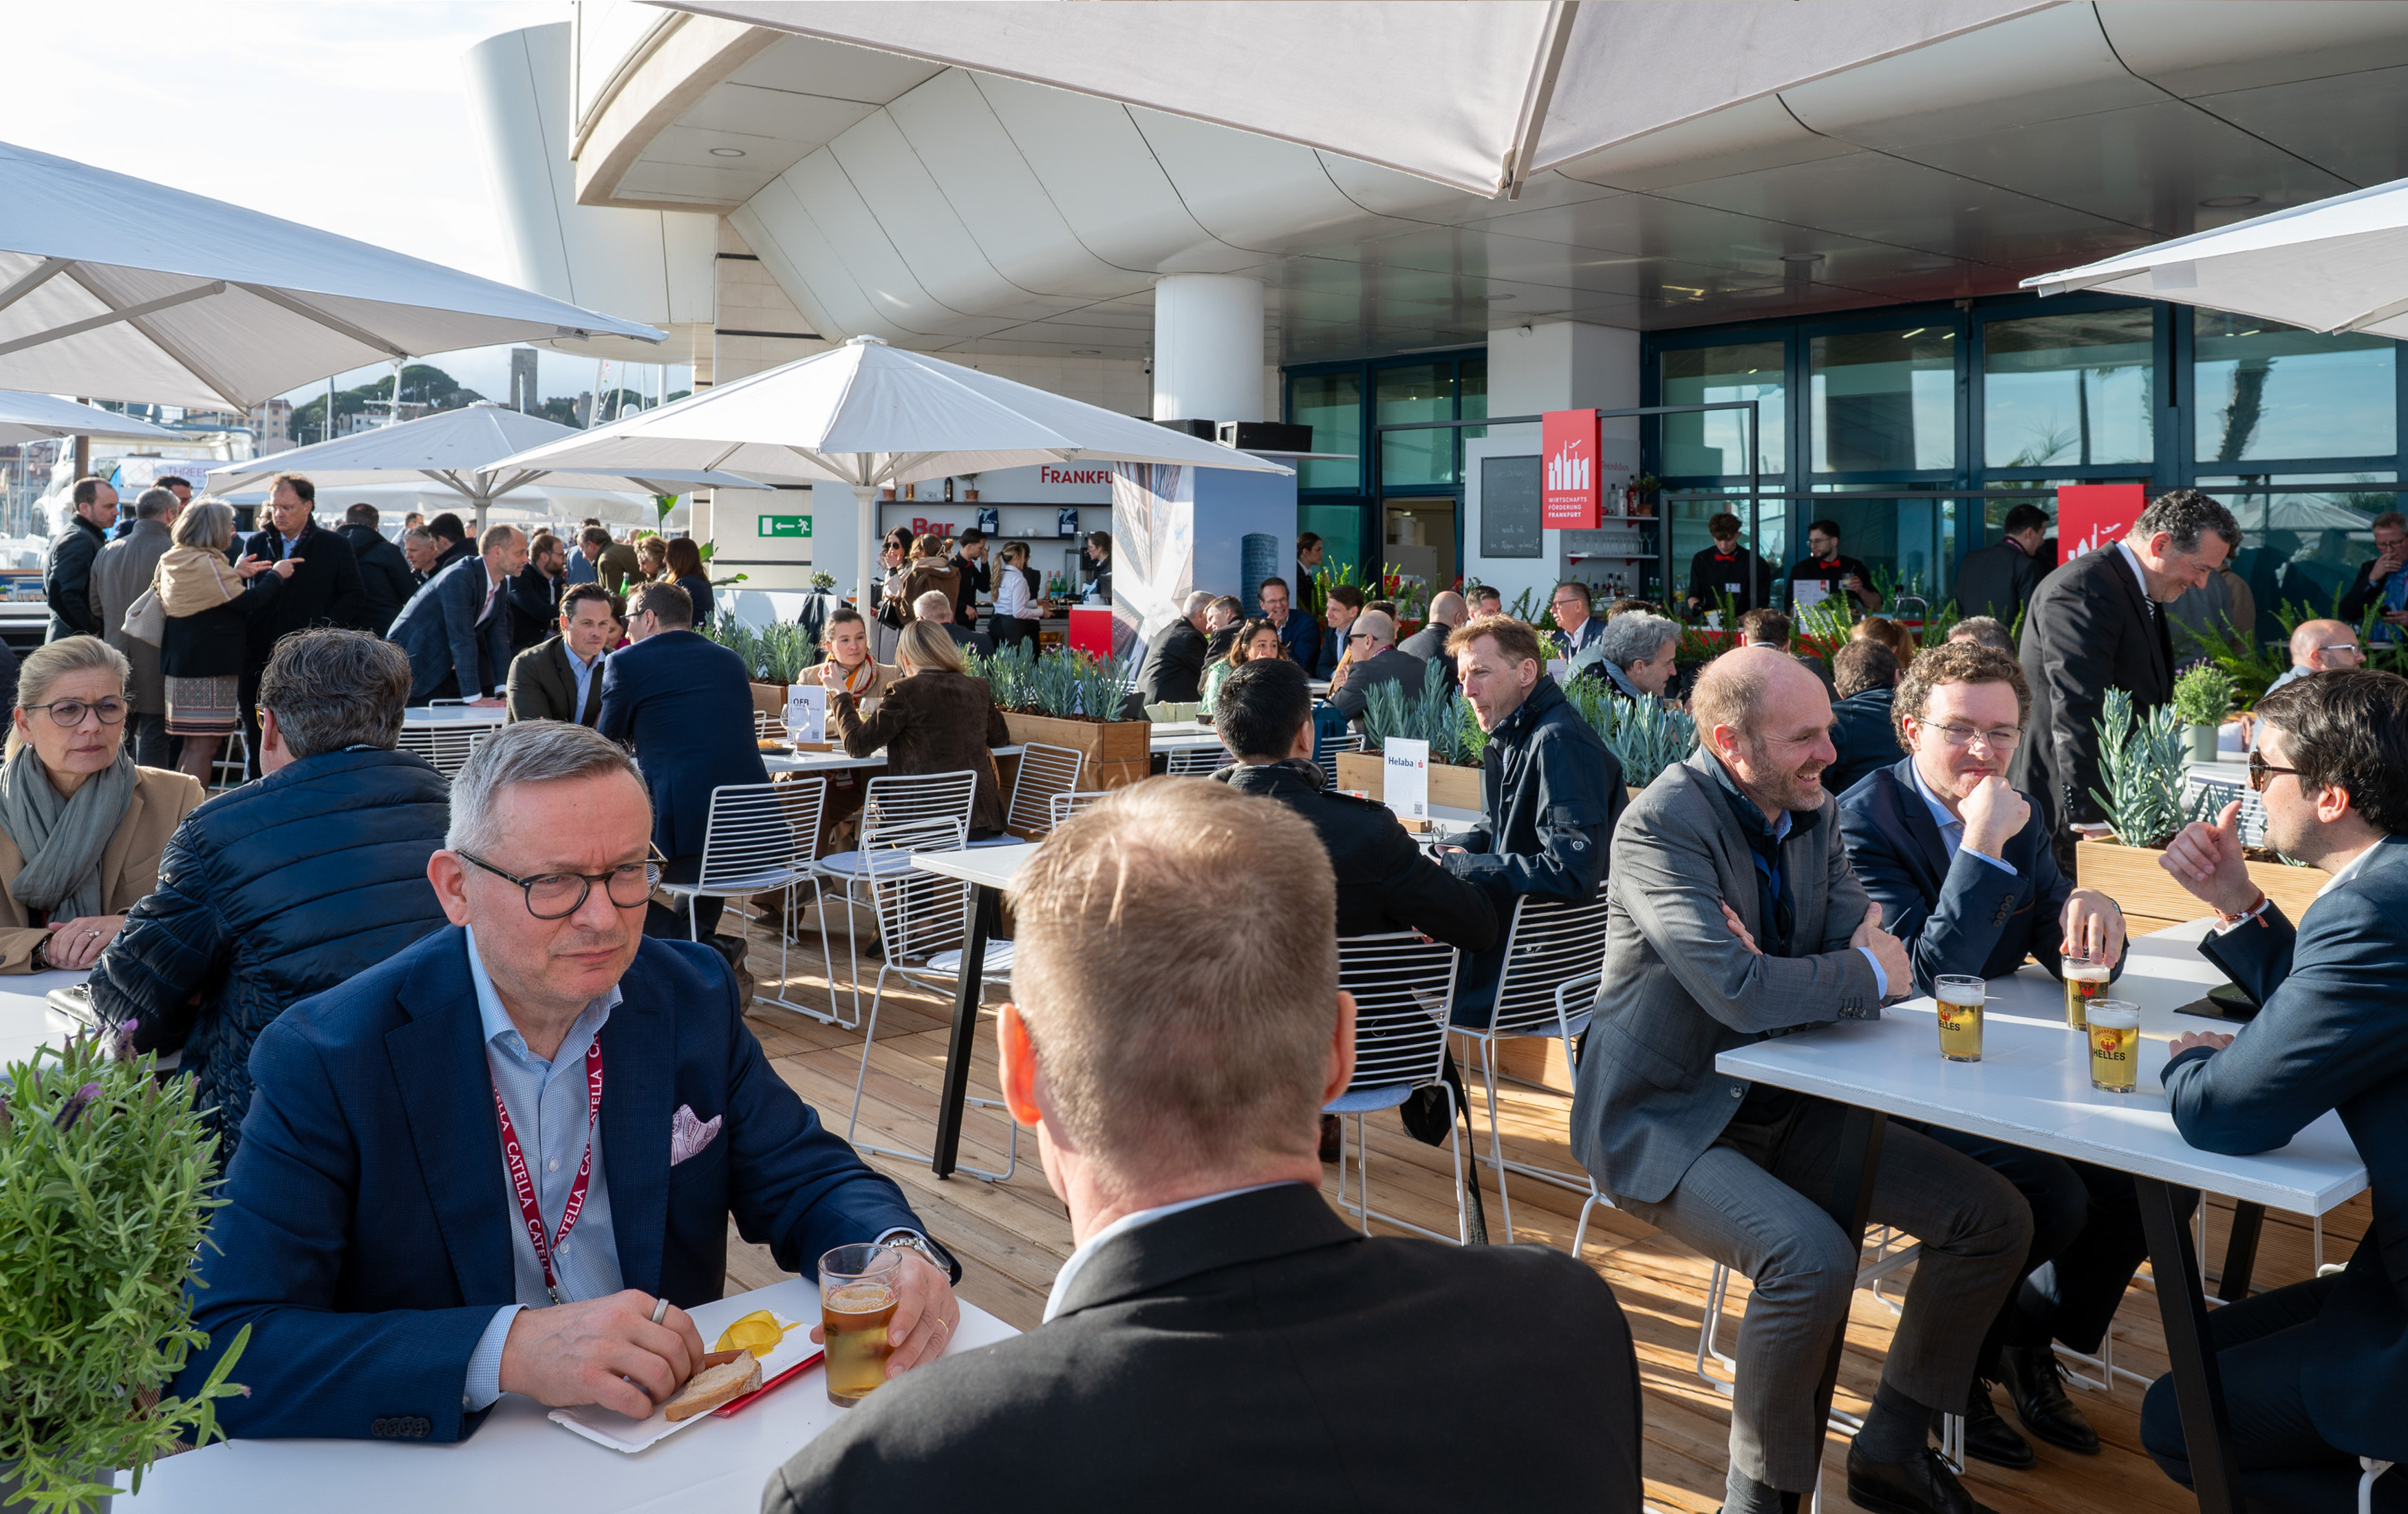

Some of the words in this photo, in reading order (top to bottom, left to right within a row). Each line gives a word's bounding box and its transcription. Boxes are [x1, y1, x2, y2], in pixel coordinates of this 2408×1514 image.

[167, 466, 211, 478] THREES
[1041, 466, 1113, 484] FRANKFU
[912, 518, 955, 537] Bar
[1388, 756, 1414, 767] Helaba
[1938, 1019, 1960, 1031] ELLES
[2094, 1048, 2125, 1061] HELLES
[590, 1069, 603, 1127] ATELLA
[507, 1142, 534, 1210] CATELLA
